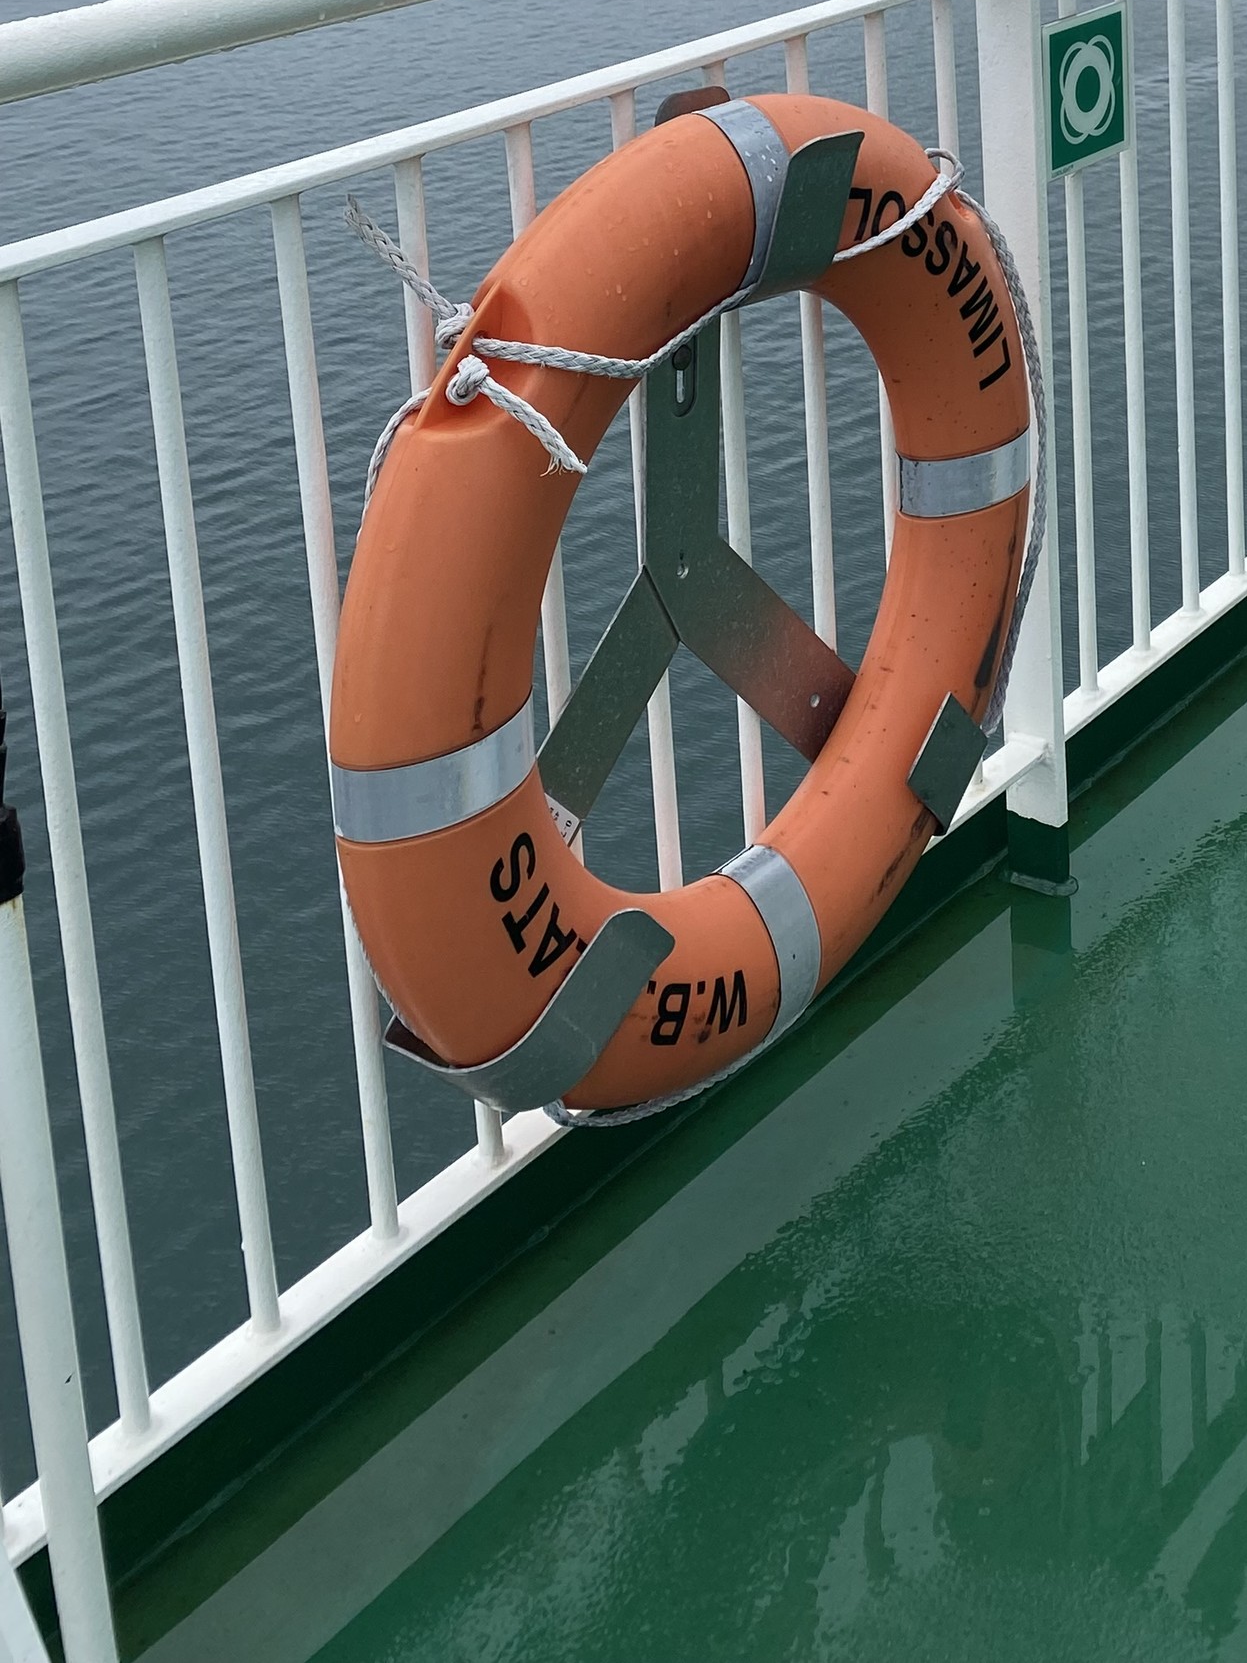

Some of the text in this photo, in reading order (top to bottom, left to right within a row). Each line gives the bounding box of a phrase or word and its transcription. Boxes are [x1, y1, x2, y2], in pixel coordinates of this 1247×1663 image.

[848, 187, 1011, 391] LIMASSOL
[489, 832, 748, 1046] W.B. ATS
